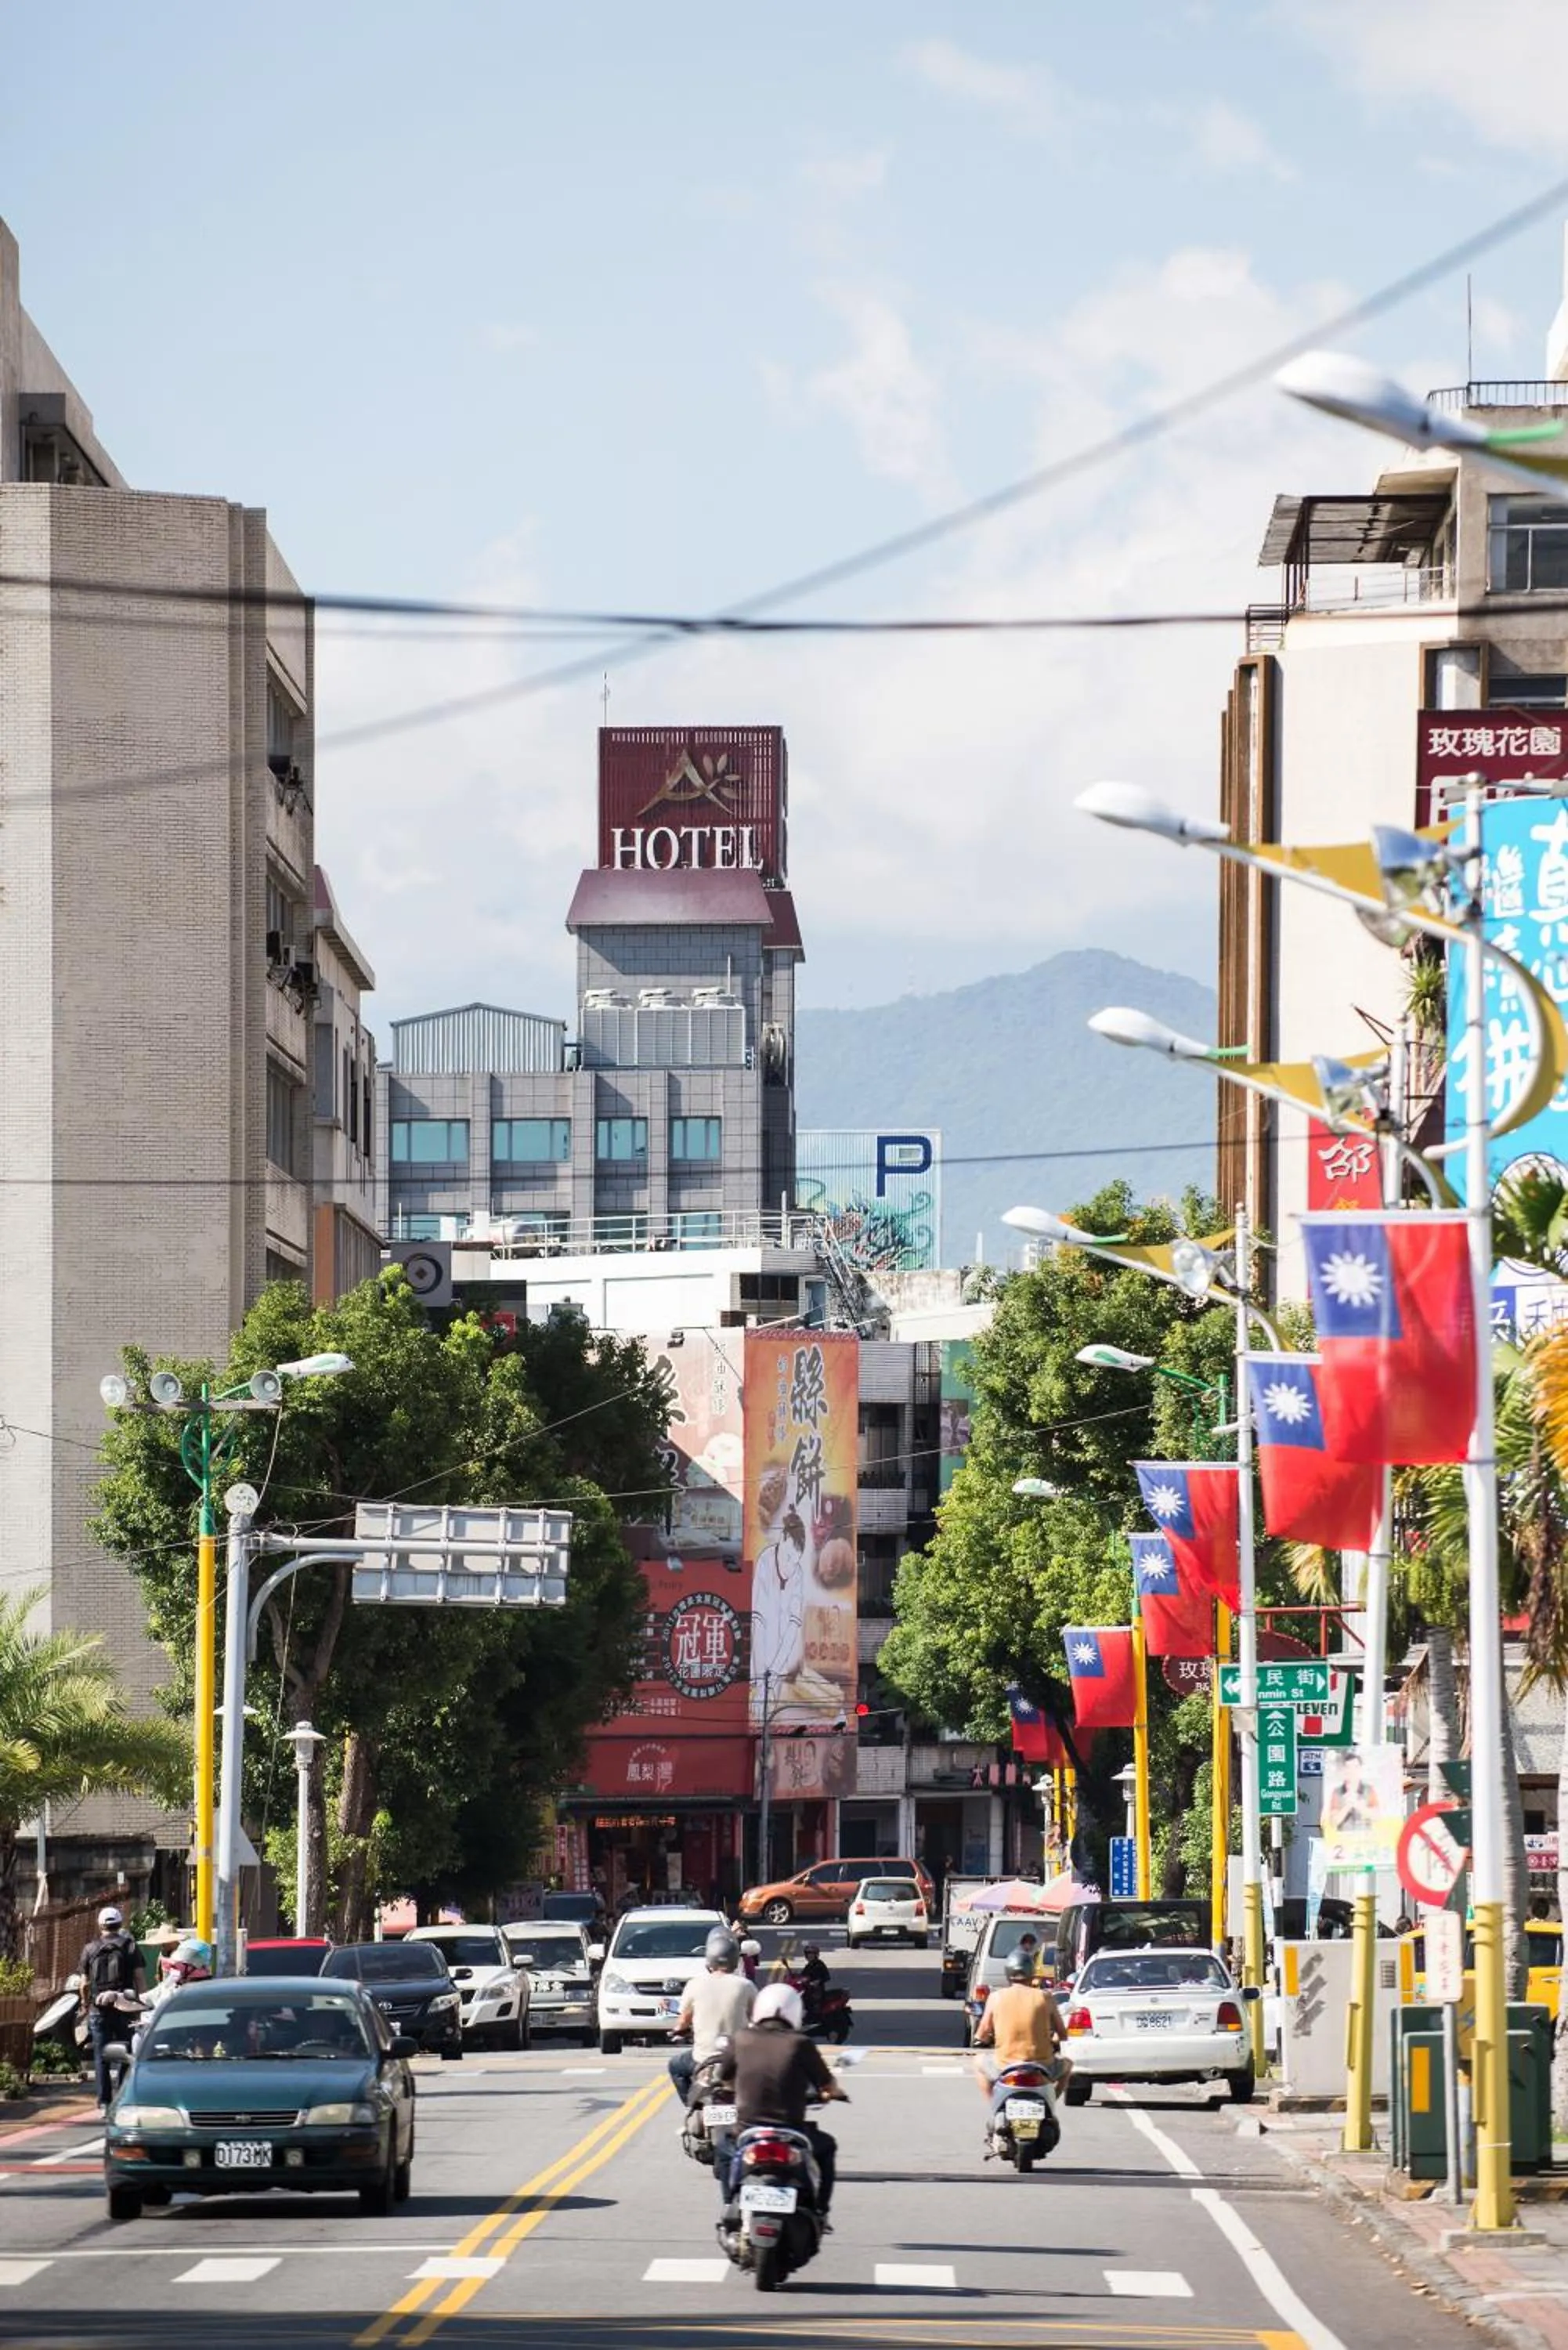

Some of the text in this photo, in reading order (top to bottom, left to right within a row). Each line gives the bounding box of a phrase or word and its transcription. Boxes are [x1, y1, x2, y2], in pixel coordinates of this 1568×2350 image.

[1428, 726, 1562, 757] 玫瑰花園
[612, 826, 764, 871] HOTEL
[876, 1135, 931, 1198] P
[675, 1612, 728, 1666] 冠軍
[1248, 1668, 1316, 1687] 民街
[1257, 1688, 1304, 1699] nmin St
[1296, 1702, 1339, 1716] LEVEn
[1266, 1719, 1287, 1788] 公園路
